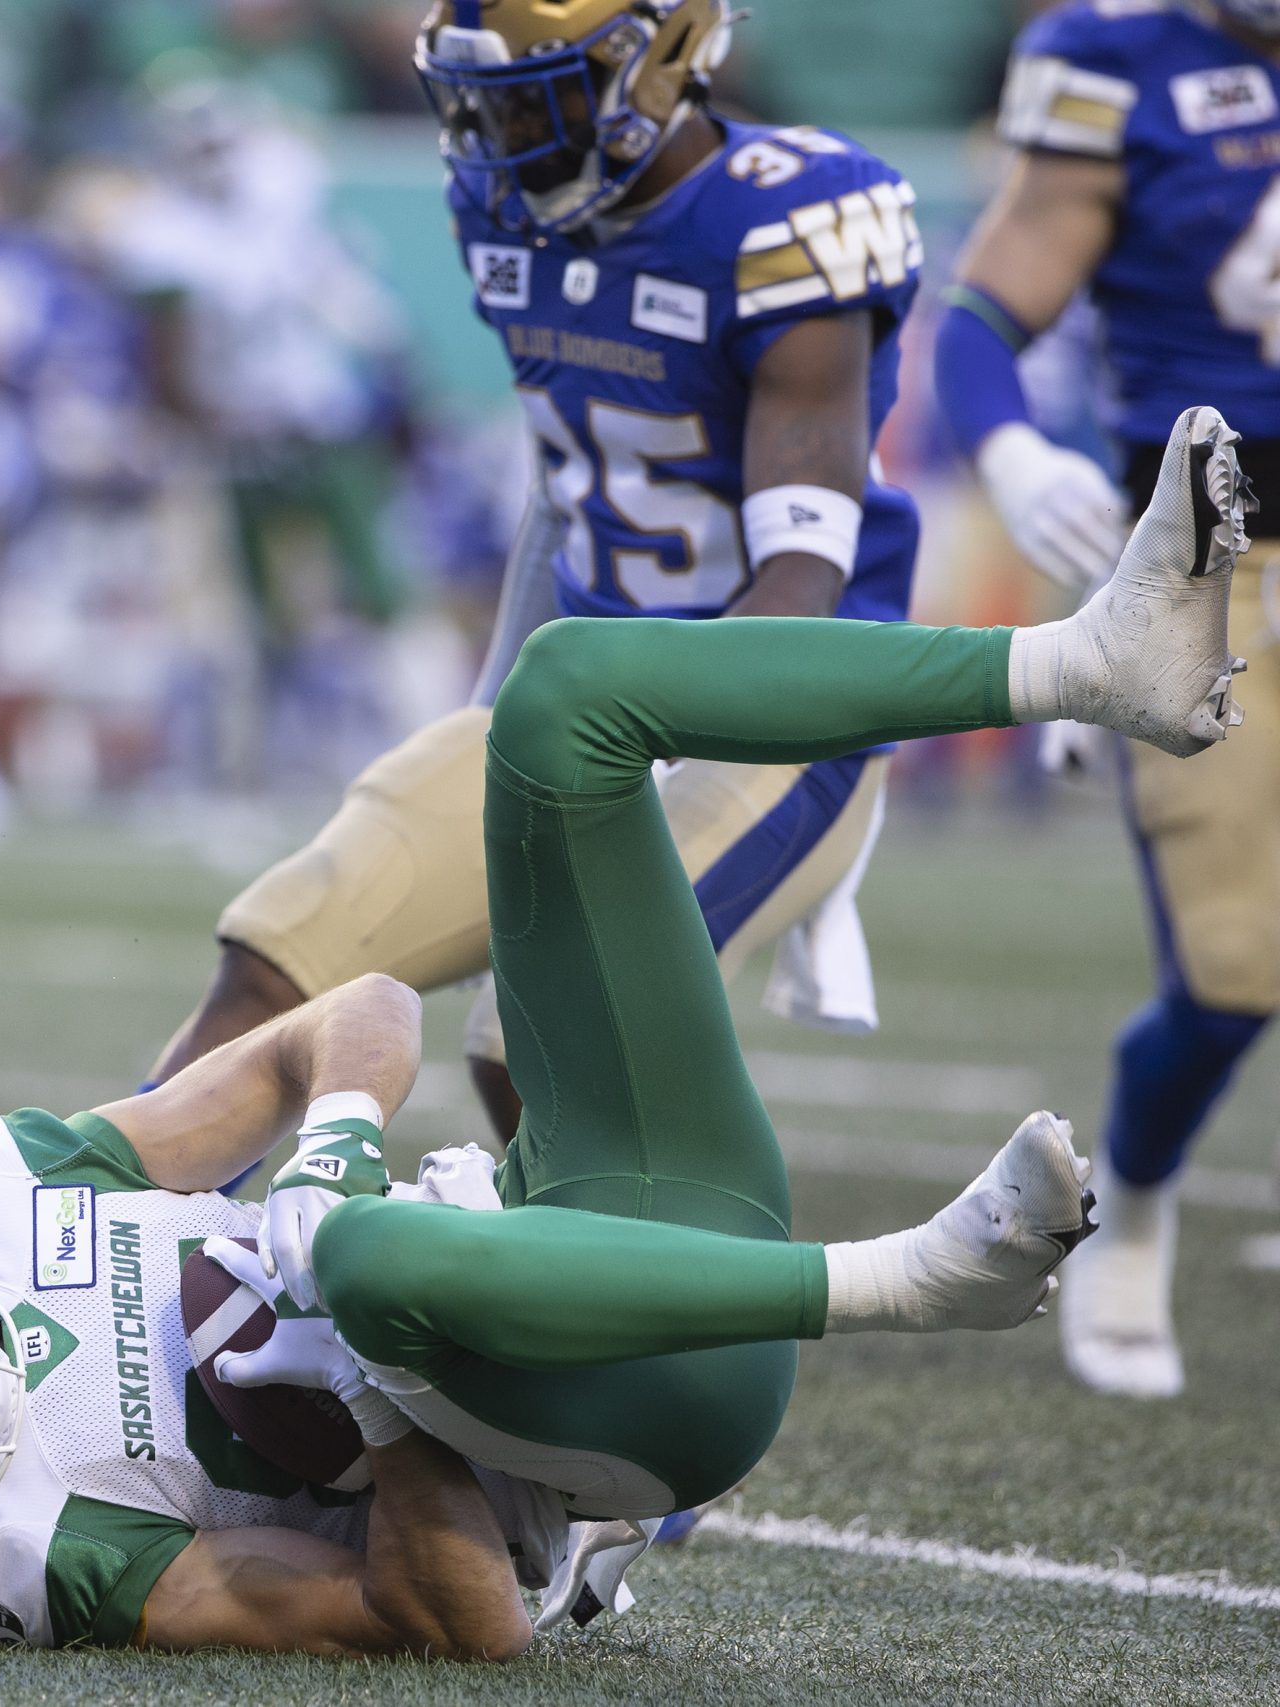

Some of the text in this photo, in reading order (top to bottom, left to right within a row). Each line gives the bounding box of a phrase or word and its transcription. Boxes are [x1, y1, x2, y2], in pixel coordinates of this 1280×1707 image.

[788, 180, 907, 303] W
[56, 1189, 76, 1261] NexGen
[27, 1331, 42, 1358] CFL
[109, 1219, 156, 1462] SASKATCHEWAN
